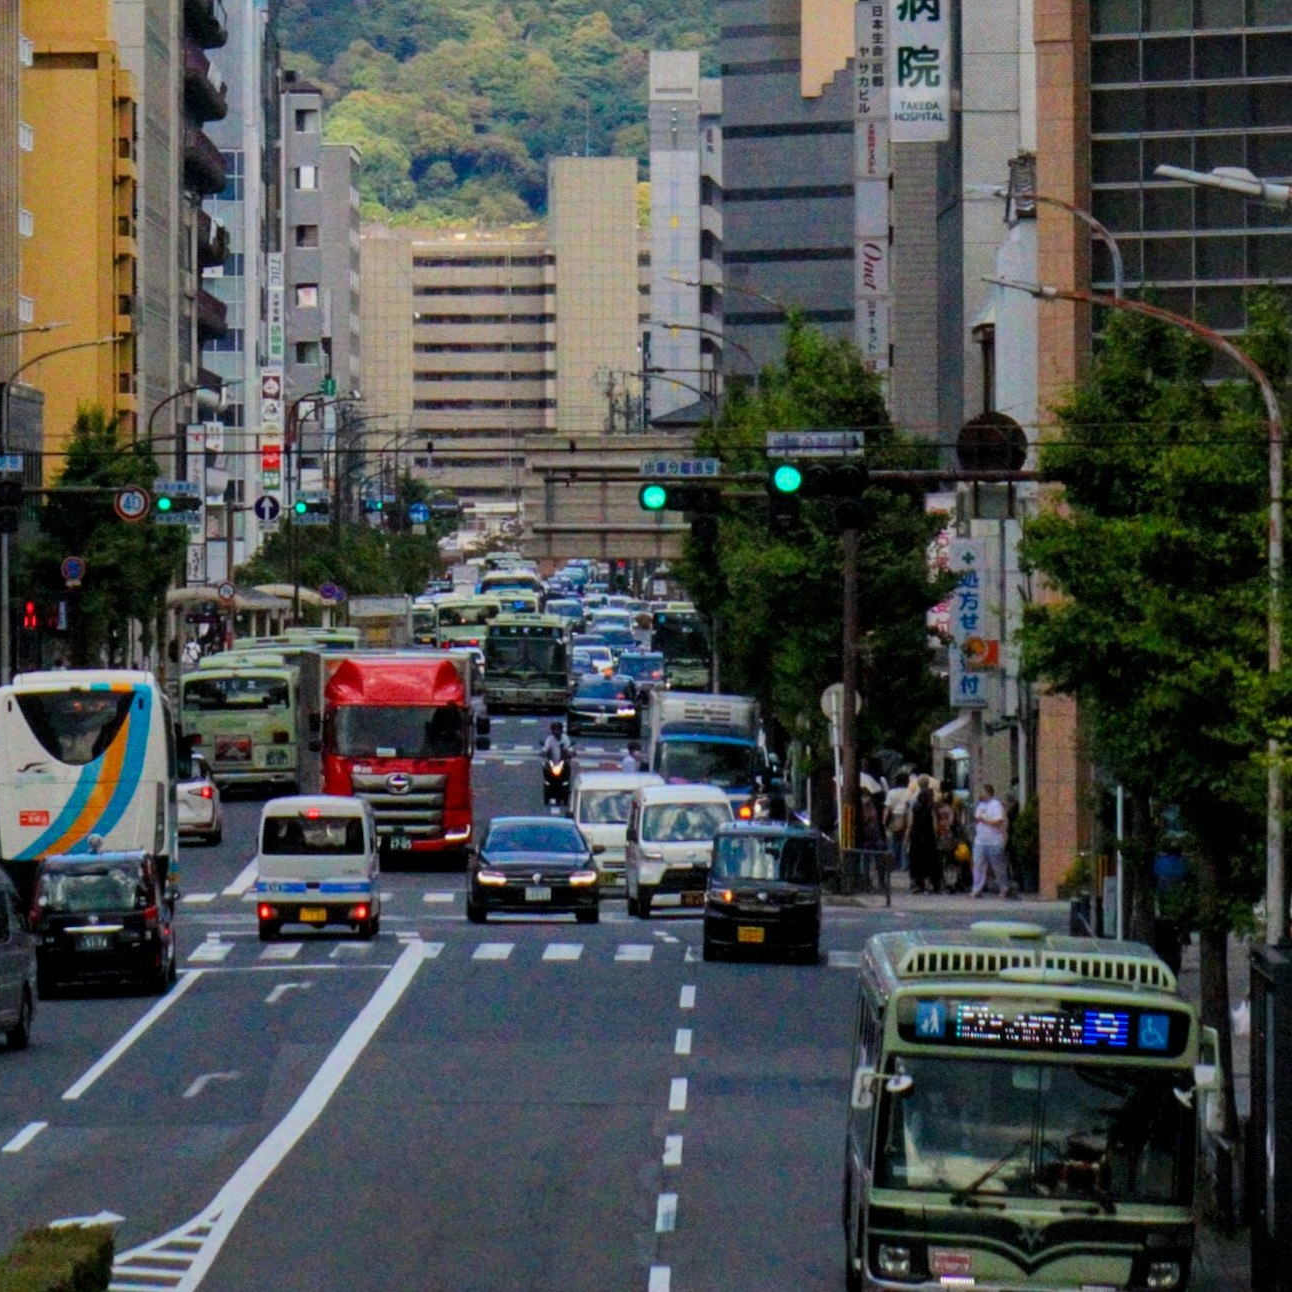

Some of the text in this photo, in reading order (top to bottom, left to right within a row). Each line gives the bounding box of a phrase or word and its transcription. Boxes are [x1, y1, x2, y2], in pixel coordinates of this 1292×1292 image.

[859, 46, 870, 114] ヤサカビル
[894, 112, 945, 121] HOSPITAL
[900, 101, 939, 110] TAKEDA
[863, 242, 882, 290] Onet
[123, 494, 142, 512] 40
[958, 571, 979, 695] 処方せ付
